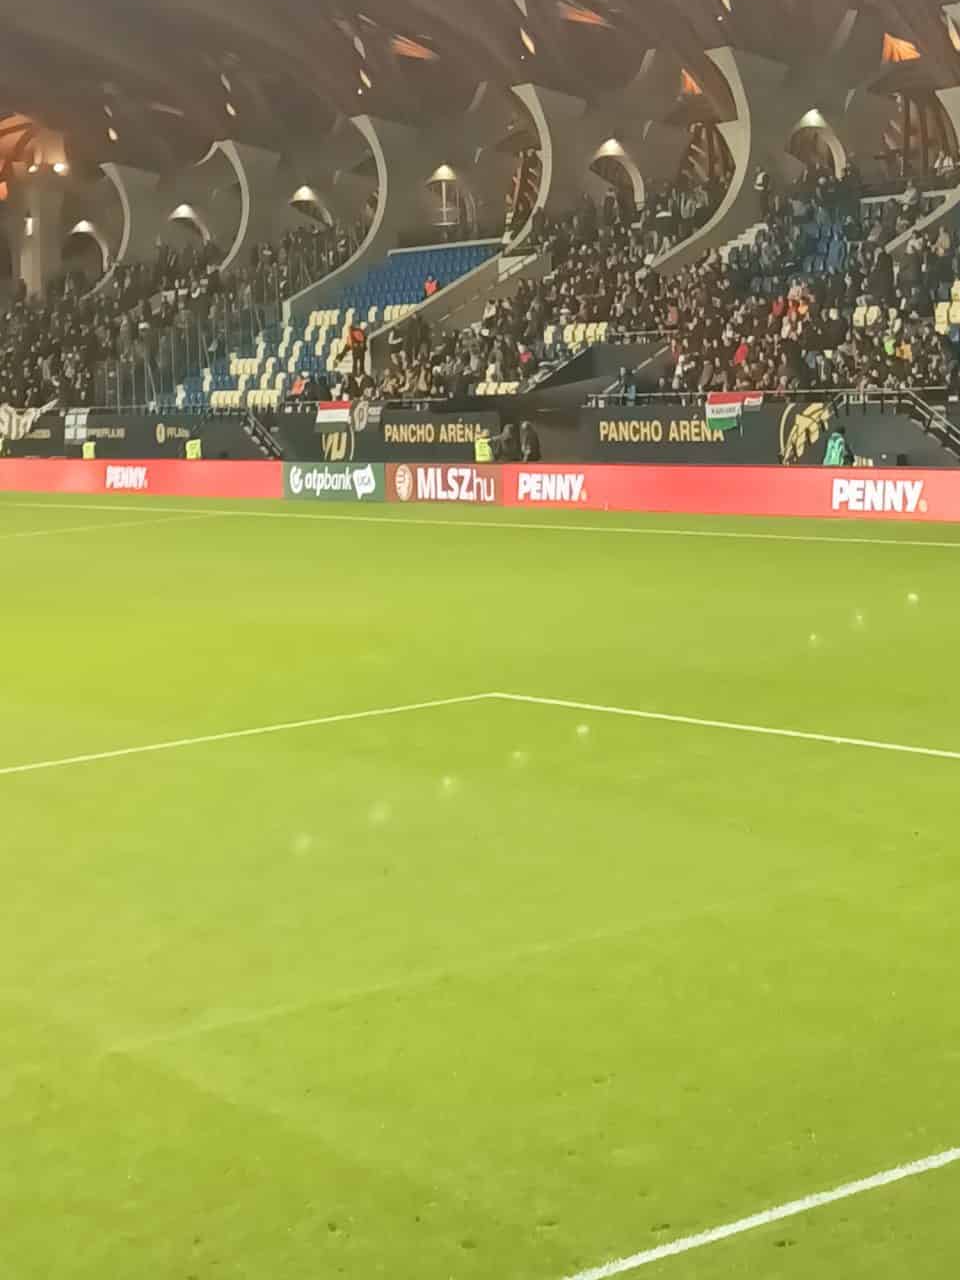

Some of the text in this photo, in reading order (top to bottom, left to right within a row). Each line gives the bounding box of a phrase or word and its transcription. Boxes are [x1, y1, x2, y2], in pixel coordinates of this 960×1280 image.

[384, 423, 435, 443] PANCHO
[599, 420, 662, 442] PANCHO
[305, 466, 352, 496] otpbank
[417, 467, 495, 502] MLSZhu
